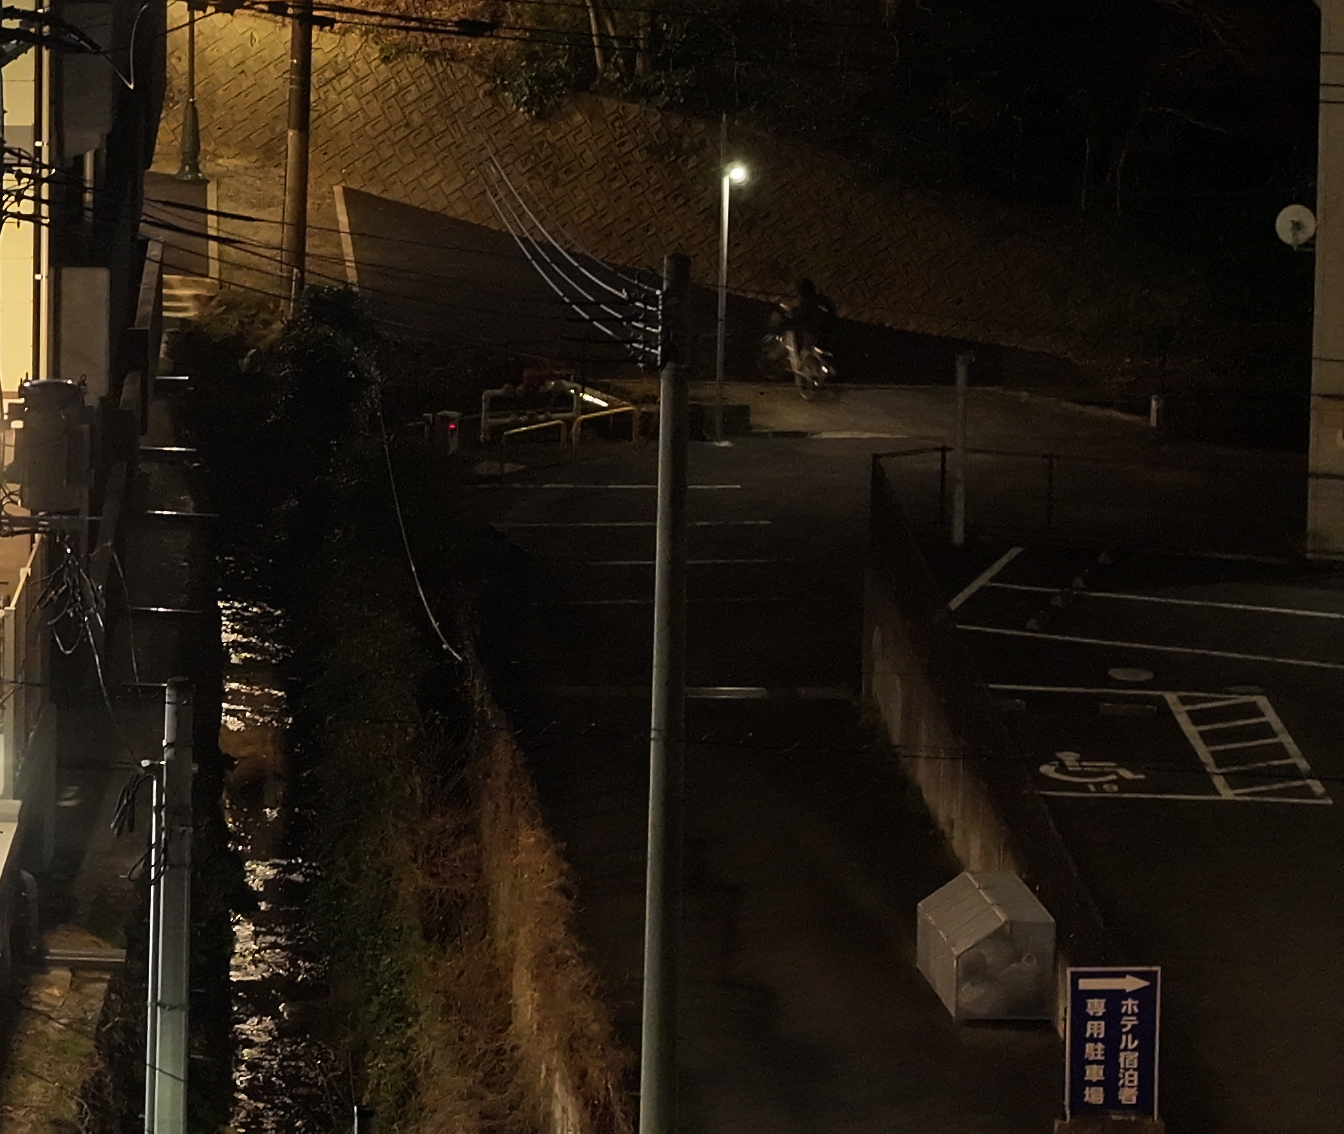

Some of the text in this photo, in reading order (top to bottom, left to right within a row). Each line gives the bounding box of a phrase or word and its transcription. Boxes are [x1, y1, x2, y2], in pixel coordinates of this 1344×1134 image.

[1084, 997, 1107, 1105] 専用駐車場
[1117, 997, 1139, 1105] ホテル宿泊者
